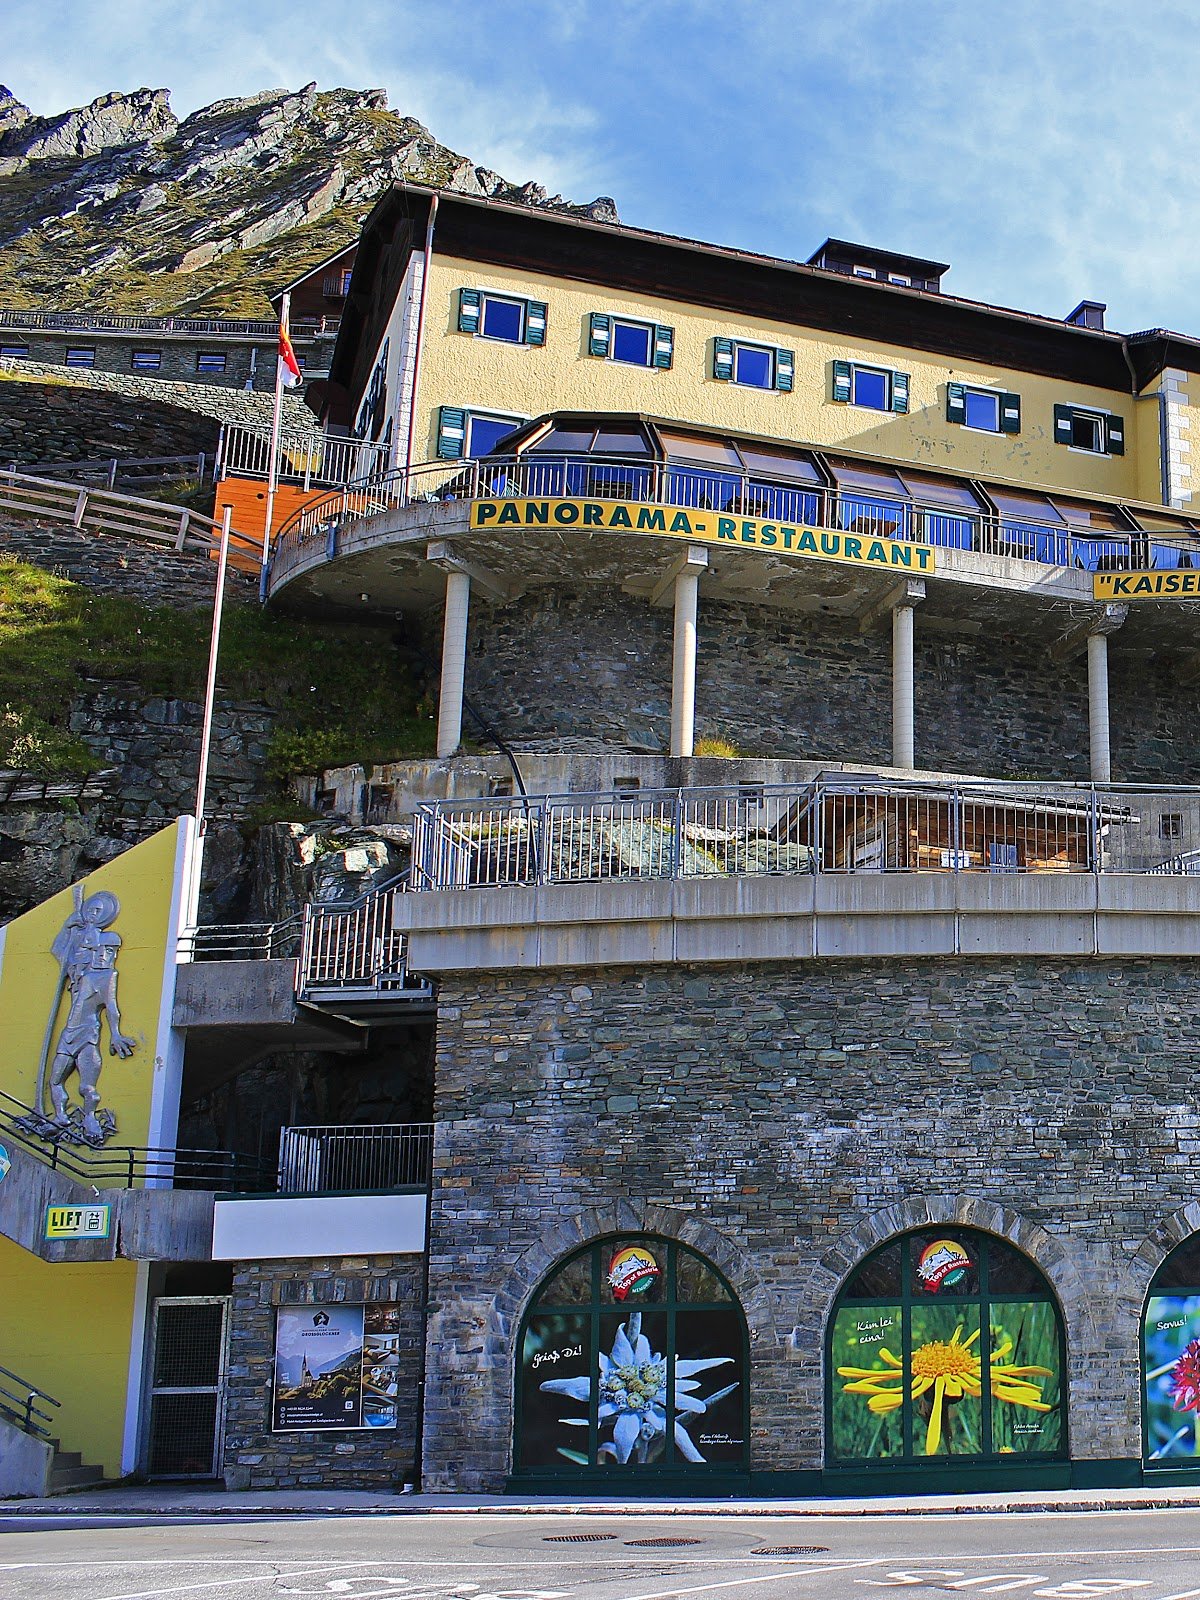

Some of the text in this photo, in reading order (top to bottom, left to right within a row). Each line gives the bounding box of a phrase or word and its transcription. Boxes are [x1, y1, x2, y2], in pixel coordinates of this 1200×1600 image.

[717, 517, 934, 569] RESTAURANT
[51, 1211, 82, 1227] LIFT
[929, 1271, 943, 1282] Top
[617, 1278, 632, 1289] Top
[857, 1320, 879, 1330] Kim
[853, 1569, 1154, 1599] BUS
